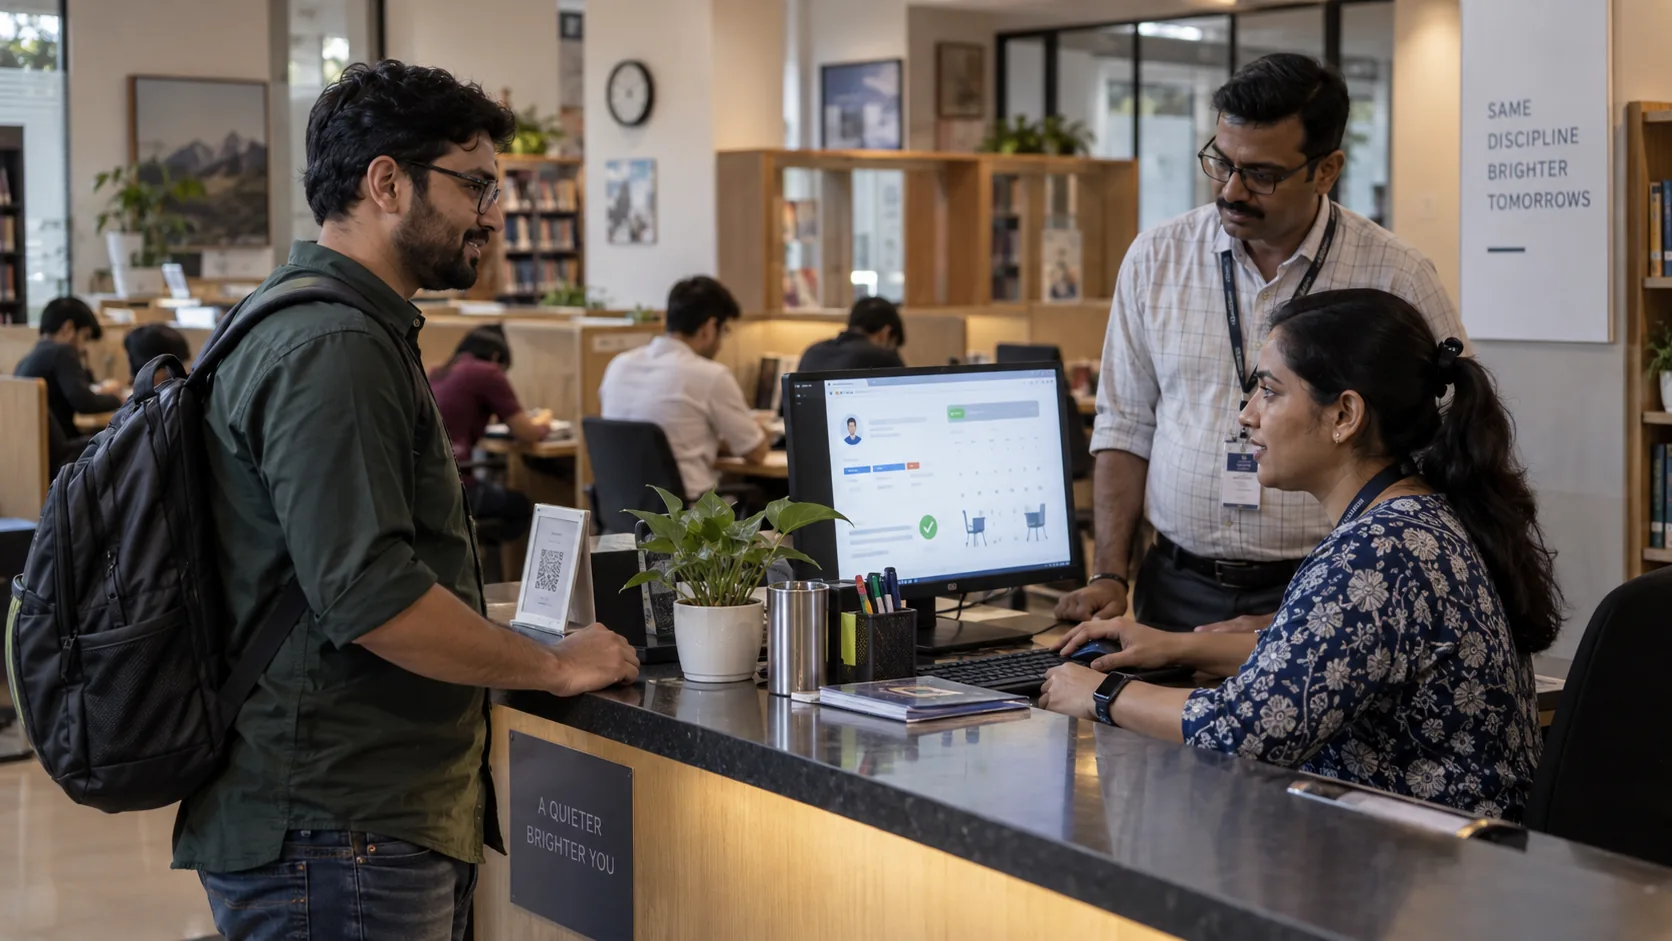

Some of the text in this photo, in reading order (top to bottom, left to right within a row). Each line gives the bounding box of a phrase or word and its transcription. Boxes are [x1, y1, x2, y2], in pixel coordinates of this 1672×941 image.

[1487, 99, 1532, 119] SAME
[1488, 126, 1579, 150] DISCIPLINE
[1487, 159, 1568, 181] BRIGHTER
[1487, 190, 1591, 212] TOMORROWS
[537, 797, 602, 837] A QUIETER
[526, 825, 615, 875] BRIGHTER YOU
